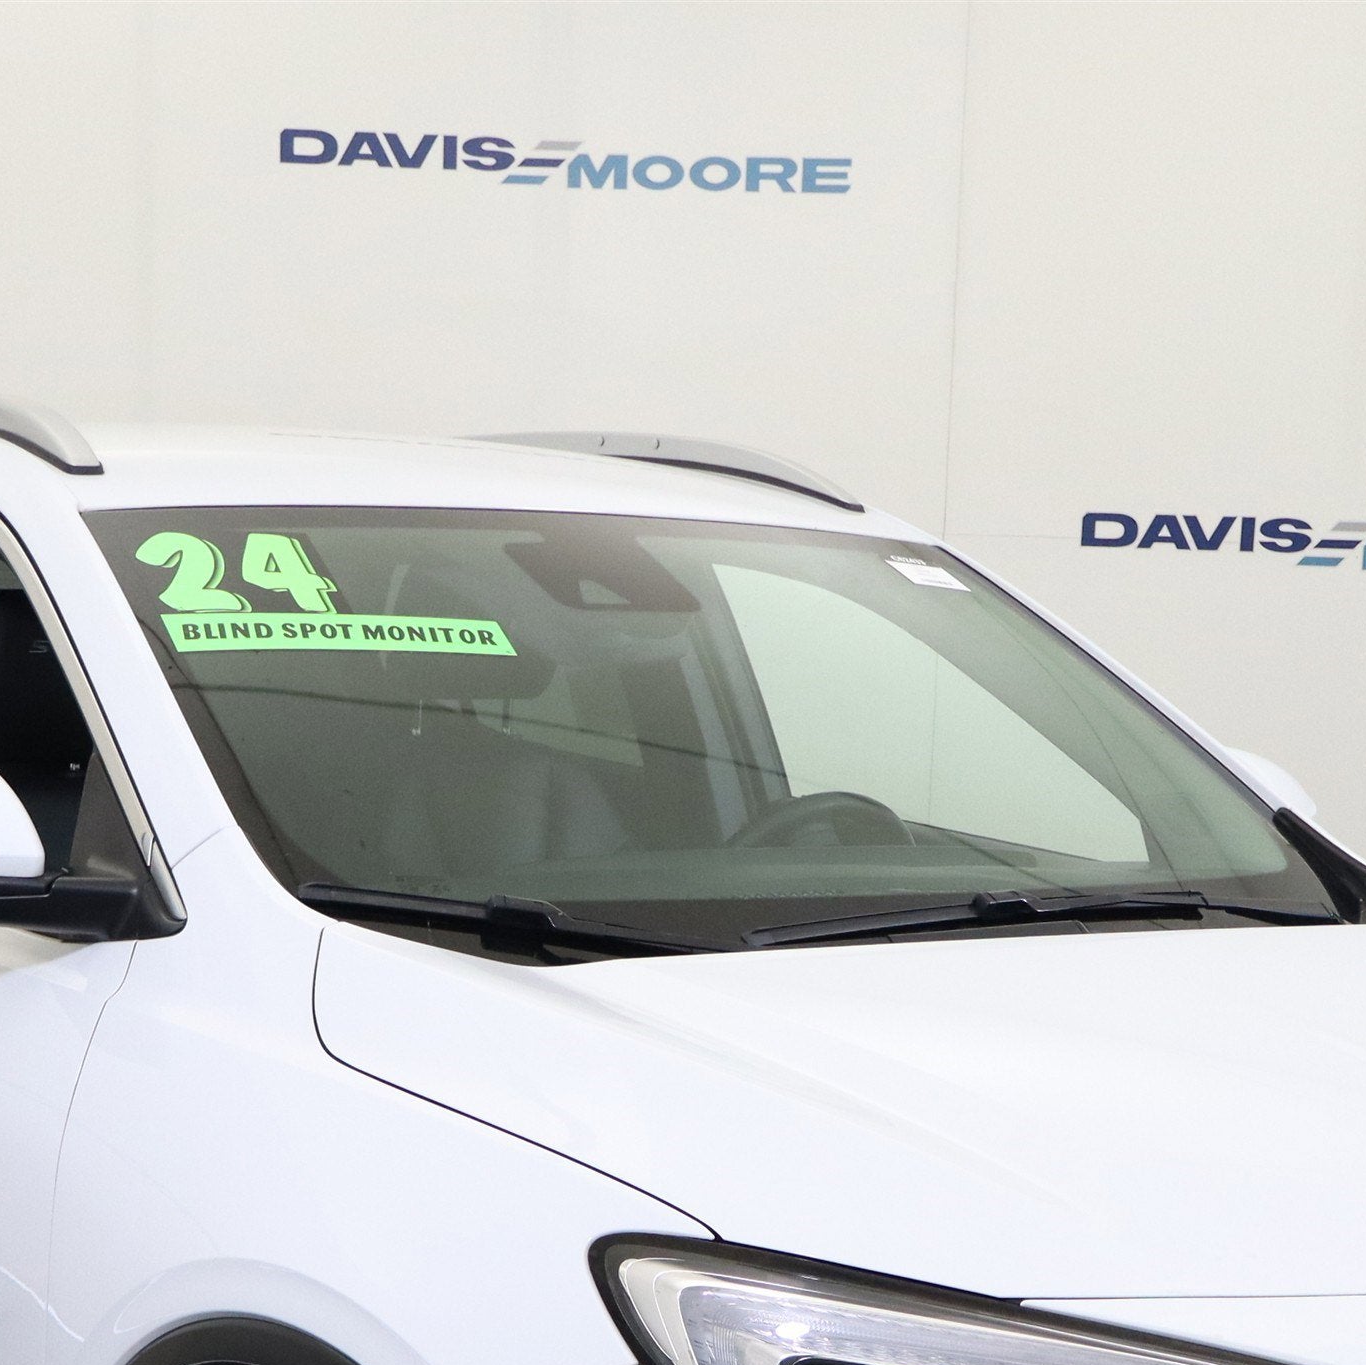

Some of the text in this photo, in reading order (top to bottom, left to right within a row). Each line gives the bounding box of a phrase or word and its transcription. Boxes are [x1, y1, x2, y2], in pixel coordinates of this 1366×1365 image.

[279, 128, 852, 194] DAVIS MOORE
[1080, 511, 1313, 554] DAVIS
[134, 532, 338, 614] 24
[181, 622, 499, 647] BLIND SPOT MONITOR
